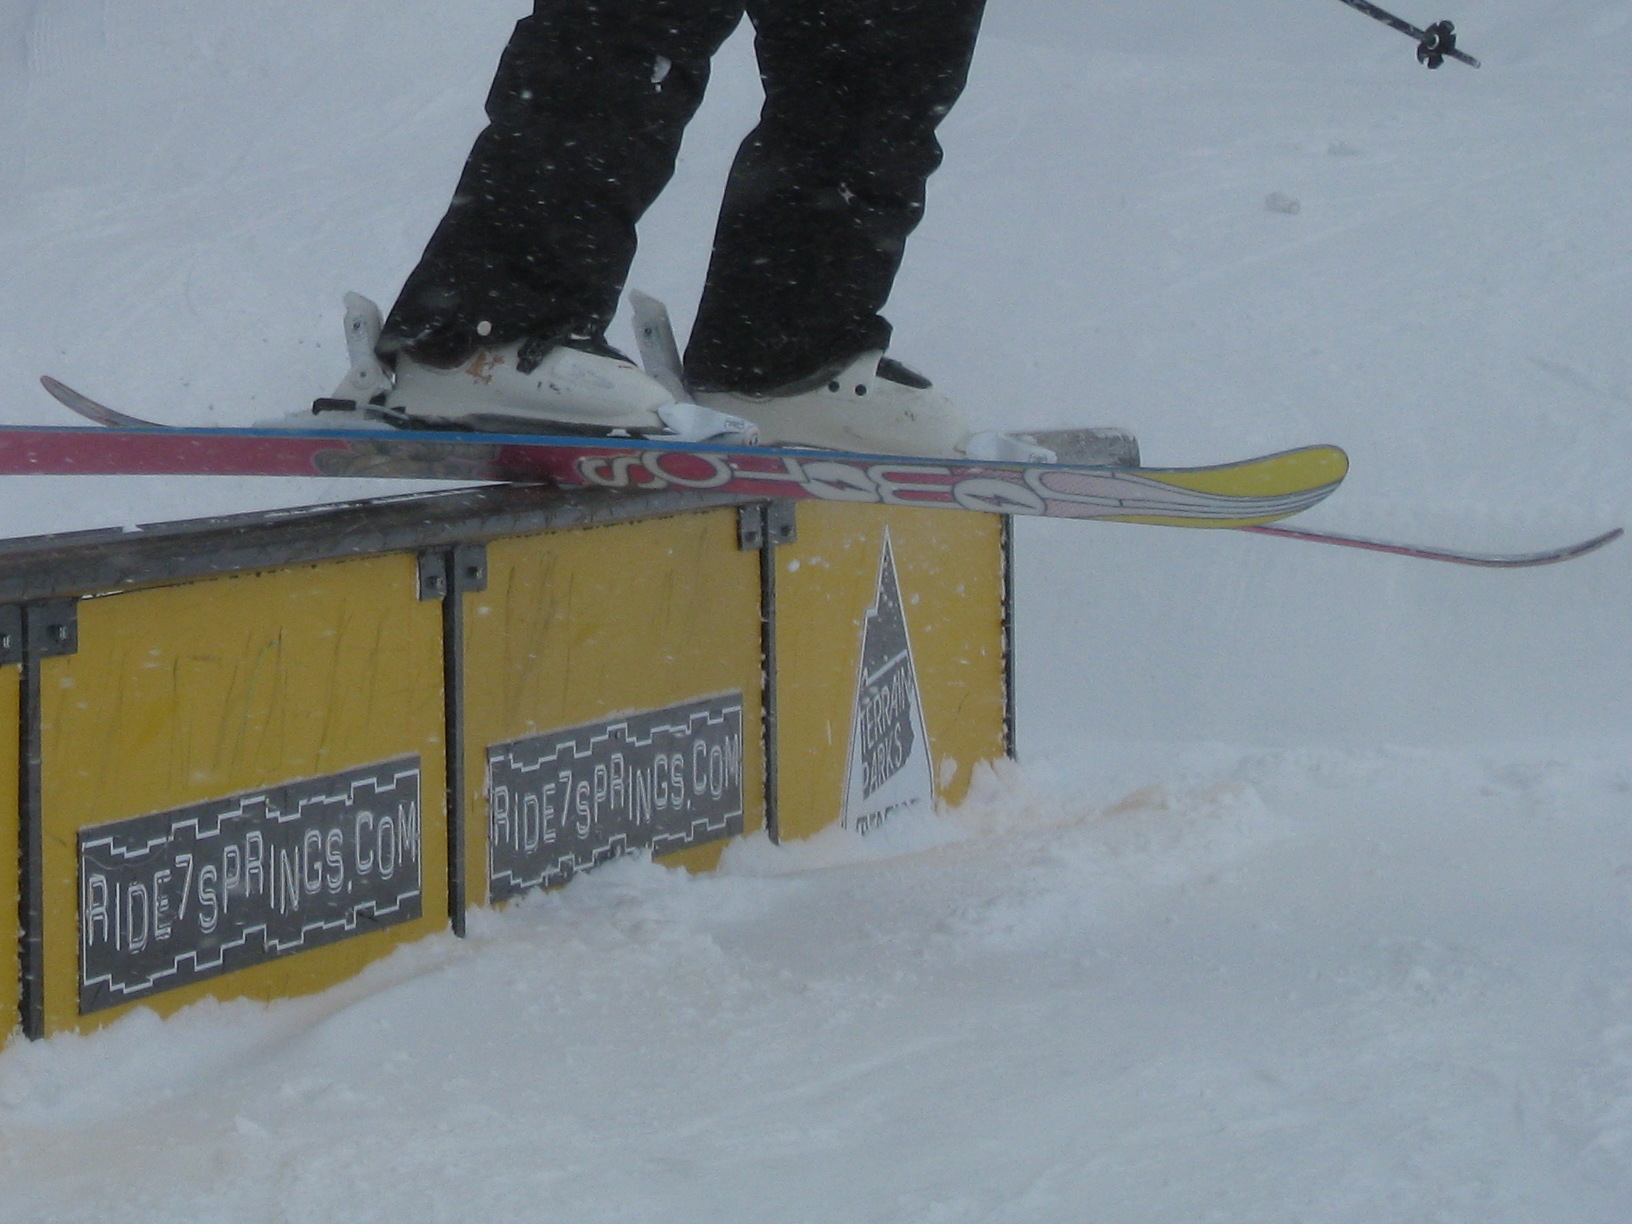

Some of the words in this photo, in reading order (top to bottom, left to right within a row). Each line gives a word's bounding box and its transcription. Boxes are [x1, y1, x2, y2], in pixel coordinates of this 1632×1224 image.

[860, 665, 911, 755] TERRAIN
[863, 722, 902, 796] PARKS
[494, 733, 738, 854] RIDE7SPRINGS.COM
[88, 800, 416, 954] RIDE7SPRINGS.COM
